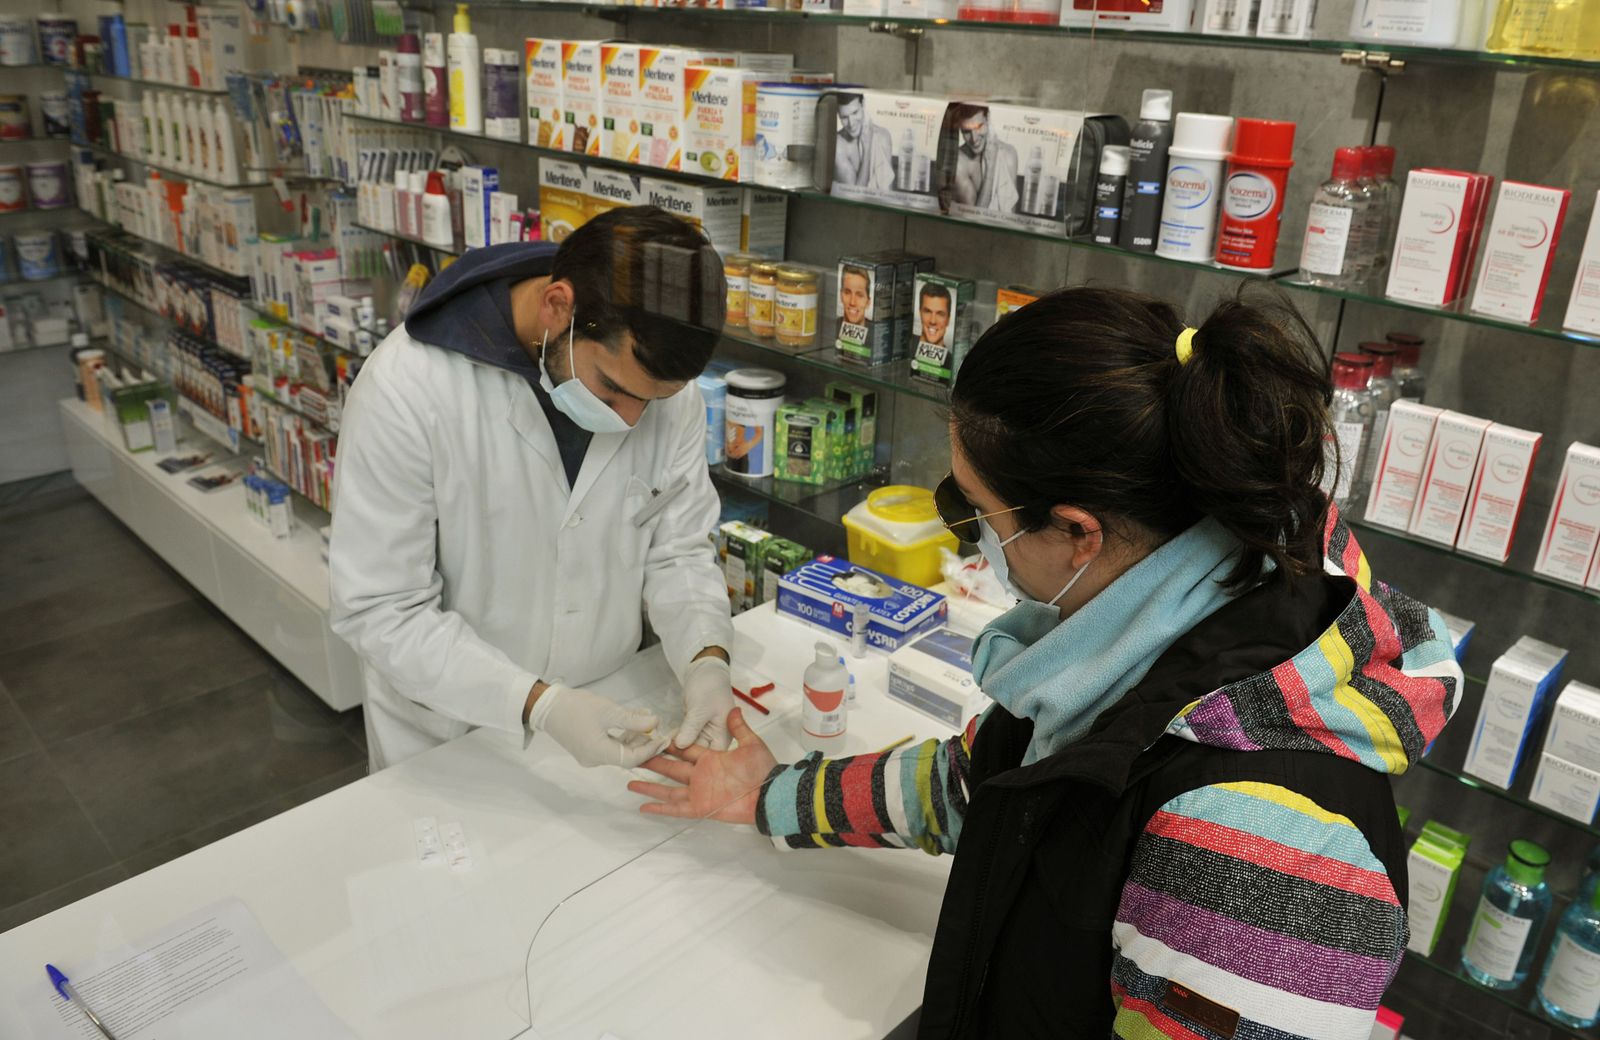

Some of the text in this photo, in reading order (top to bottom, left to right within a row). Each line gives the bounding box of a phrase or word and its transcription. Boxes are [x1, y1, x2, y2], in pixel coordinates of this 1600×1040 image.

[692, 90, 728, 106] Meritene
[545, 170, 581, 189] Meritene
[1412, 177, 1460, 189] BIODERMA
[593, 180, 631, 201] Meritene
[1504, 189, 1556, 203] BIODERMA
[649, 191, 692, 213] Meritene
[842, 327, 865, 340] MEN
[919, 348, 944, 361] MEN
[798, 602, 813, 616] 100
[871, 606, 891, 618] LATEX
[846, 620, 897, 650] CYSAN
[1561, 706, 1600, 726] BIODER
